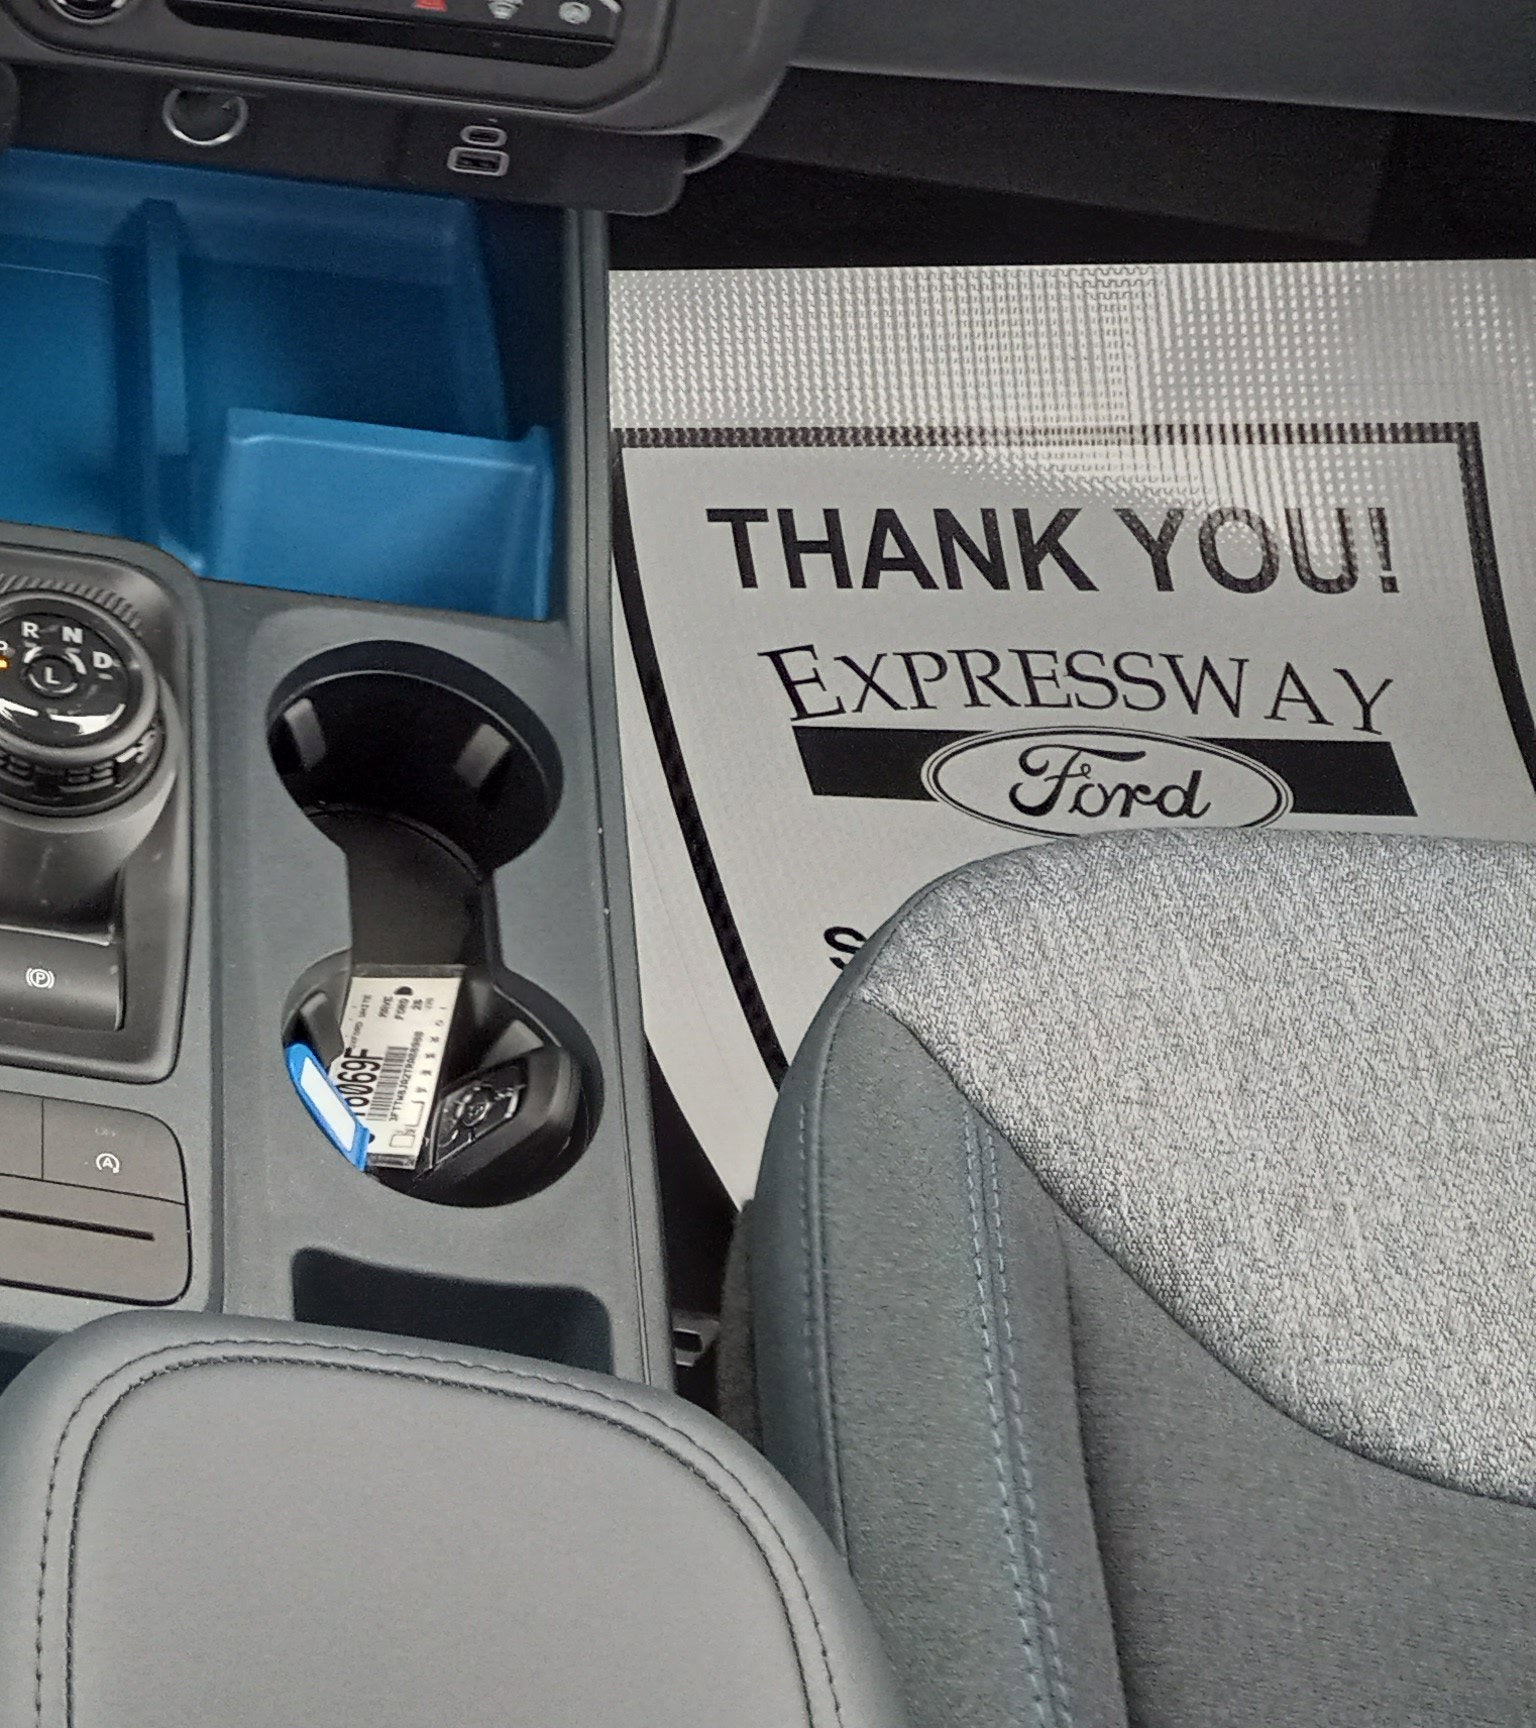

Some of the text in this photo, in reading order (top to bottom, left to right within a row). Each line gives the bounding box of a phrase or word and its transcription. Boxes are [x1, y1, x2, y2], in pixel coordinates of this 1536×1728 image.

[706, 505, 1401, 595] THANK YOU!
[21, 621, 40, 639] R
[61, 626, 84, 644] N
[92, 651, 115, 669] D
[1007, 744, 1214, 821] Ford
